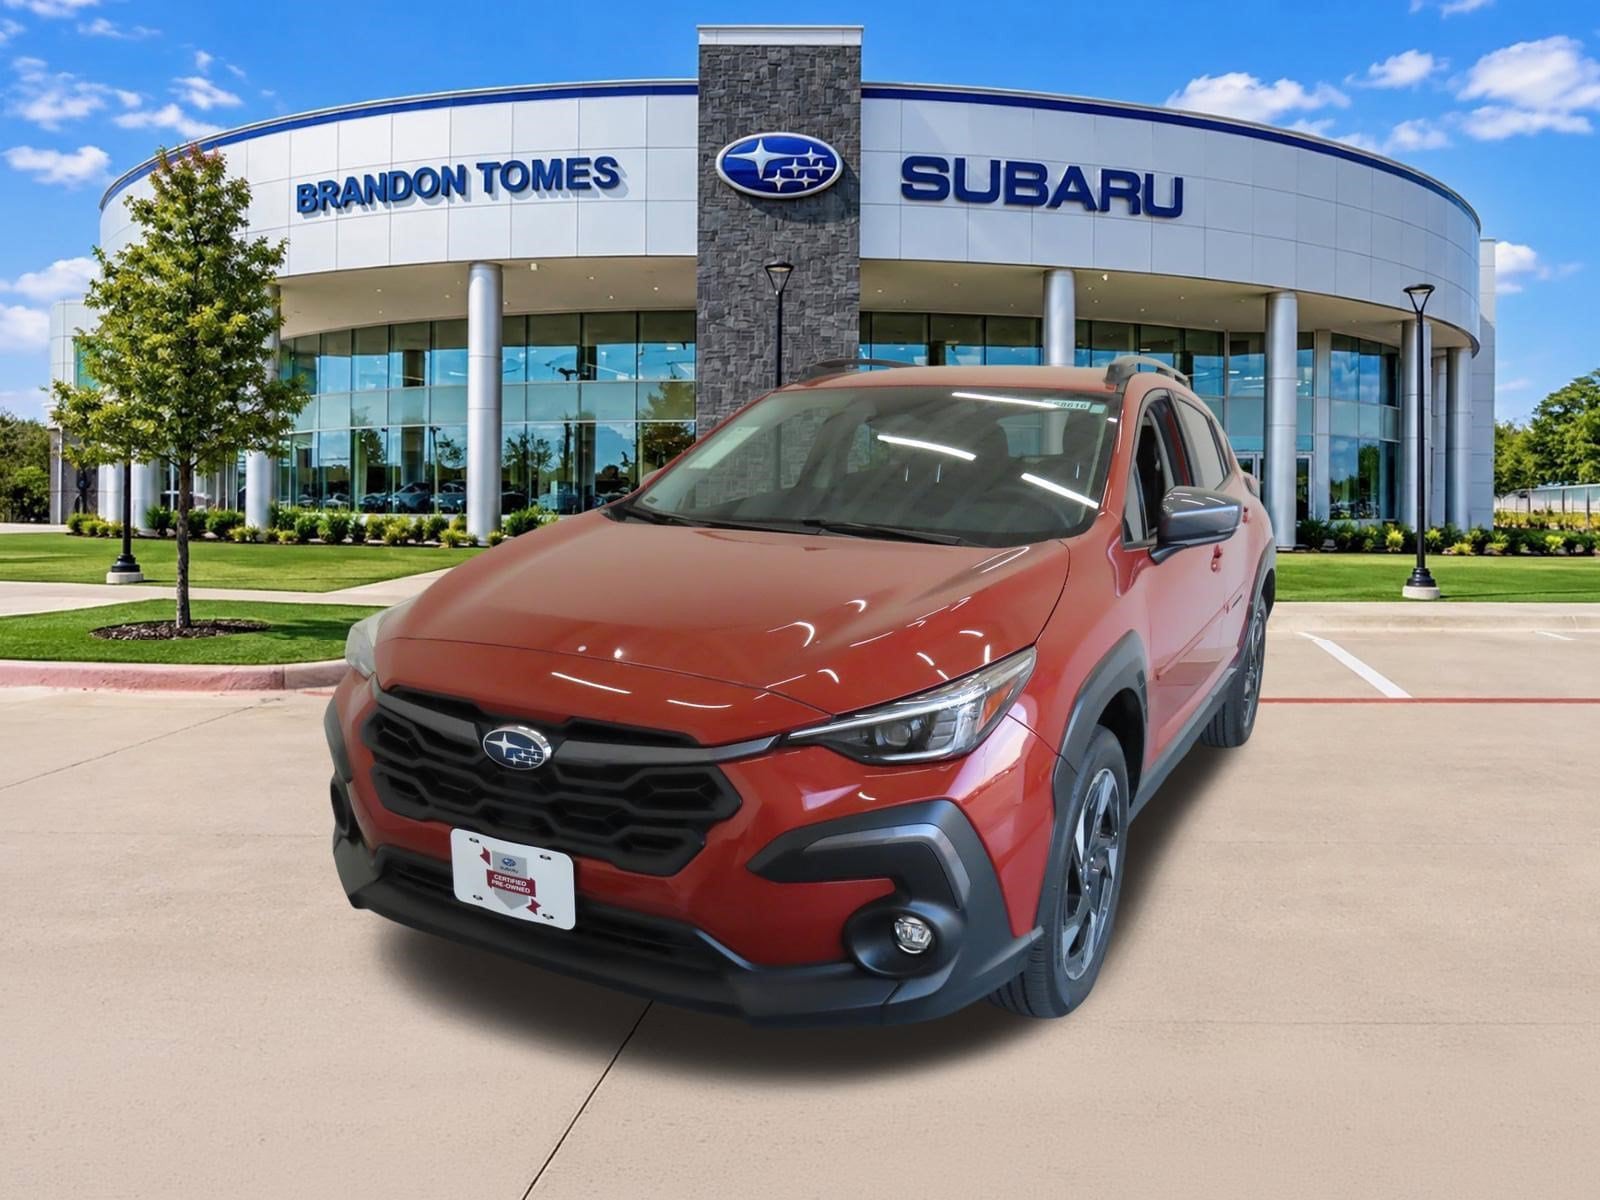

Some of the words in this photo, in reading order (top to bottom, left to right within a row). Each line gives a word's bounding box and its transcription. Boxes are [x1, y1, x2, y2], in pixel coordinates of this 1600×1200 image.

[296, 163, 468, 214] BRANDON
[476, 156, 620, 194] TOMES
[901, 155, 1183, 218] SUBARU
[491, 879, 531, 894] PRE-OWNED
[493, 874, 527, 887] CERTIFIED
